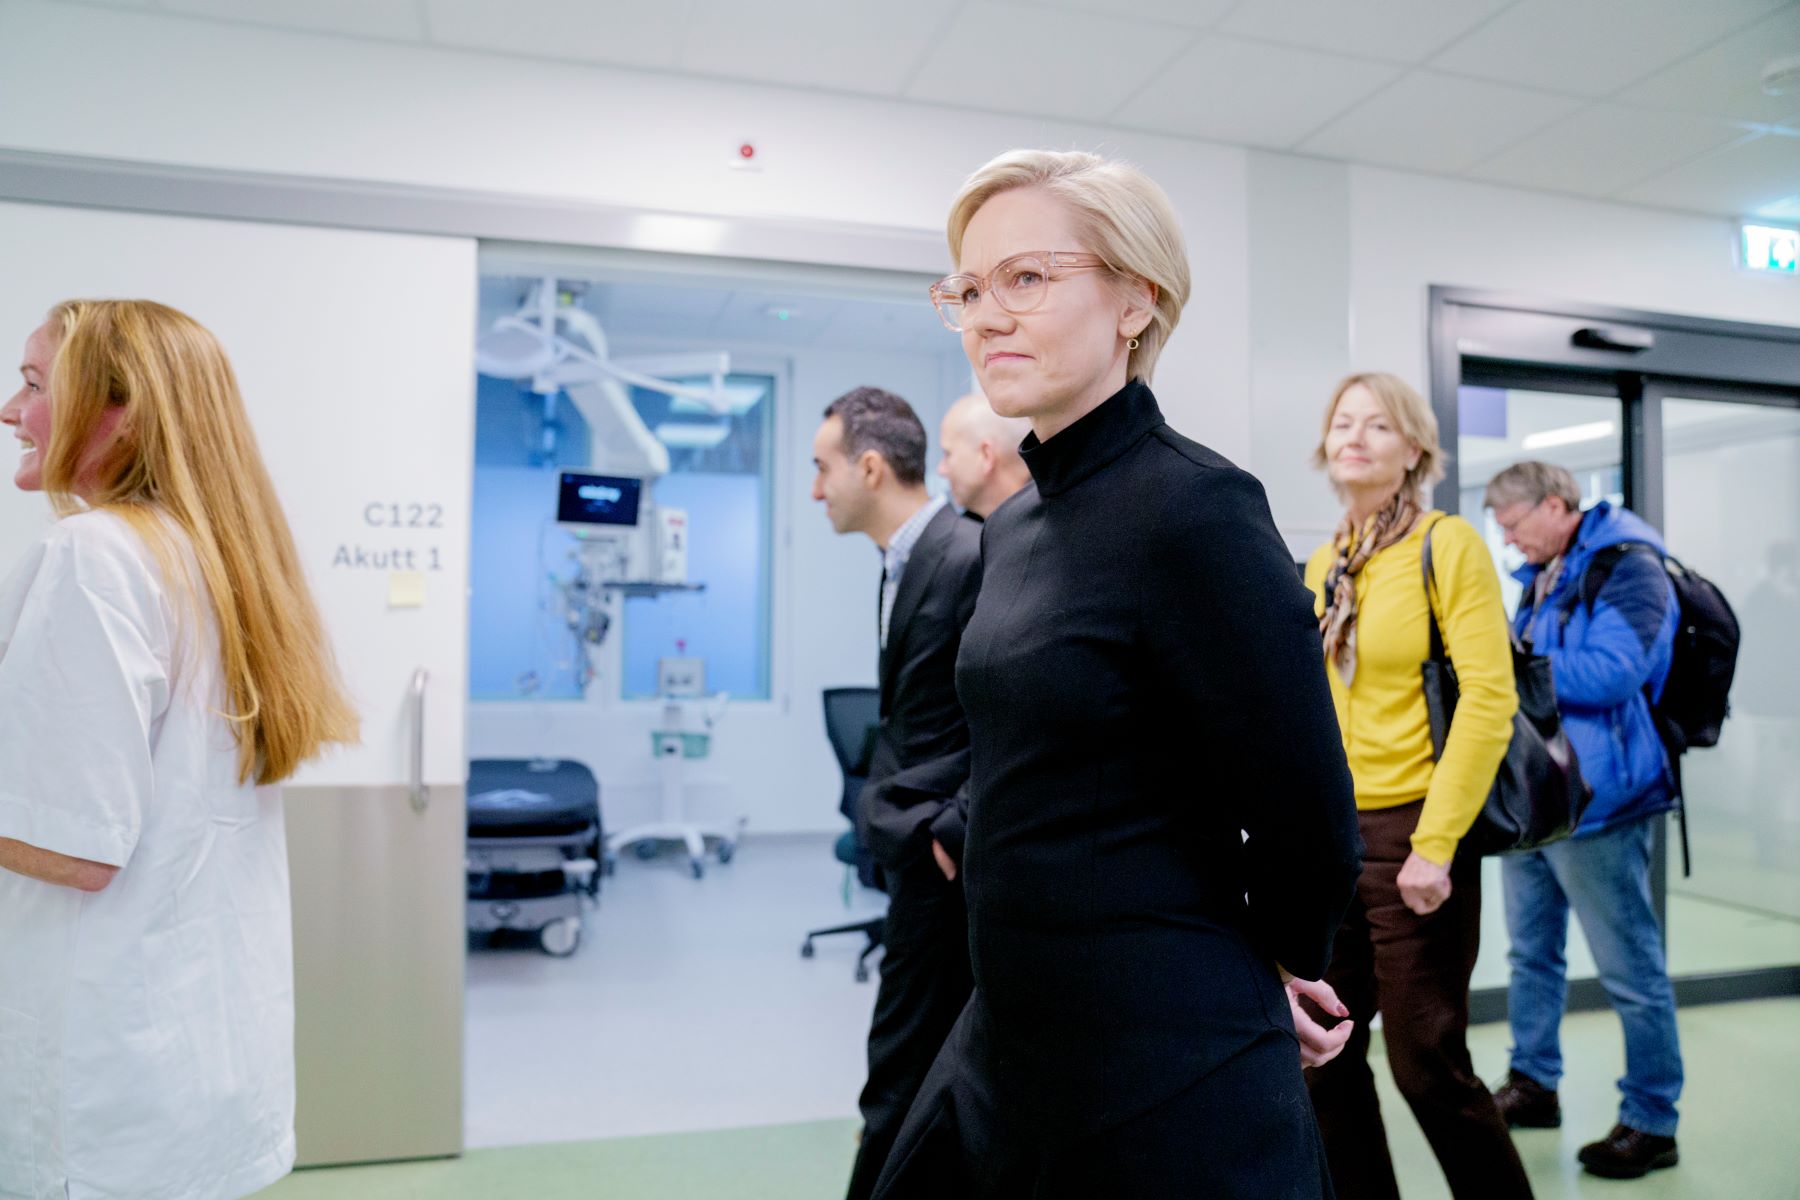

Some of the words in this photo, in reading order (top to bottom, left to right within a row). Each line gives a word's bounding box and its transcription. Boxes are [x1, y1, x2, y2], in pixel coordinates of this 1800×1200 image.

[364, 502, 443, 527] C122
[333, 545, 416, 569] Akutt
[429, 547, 443, 570] 1
